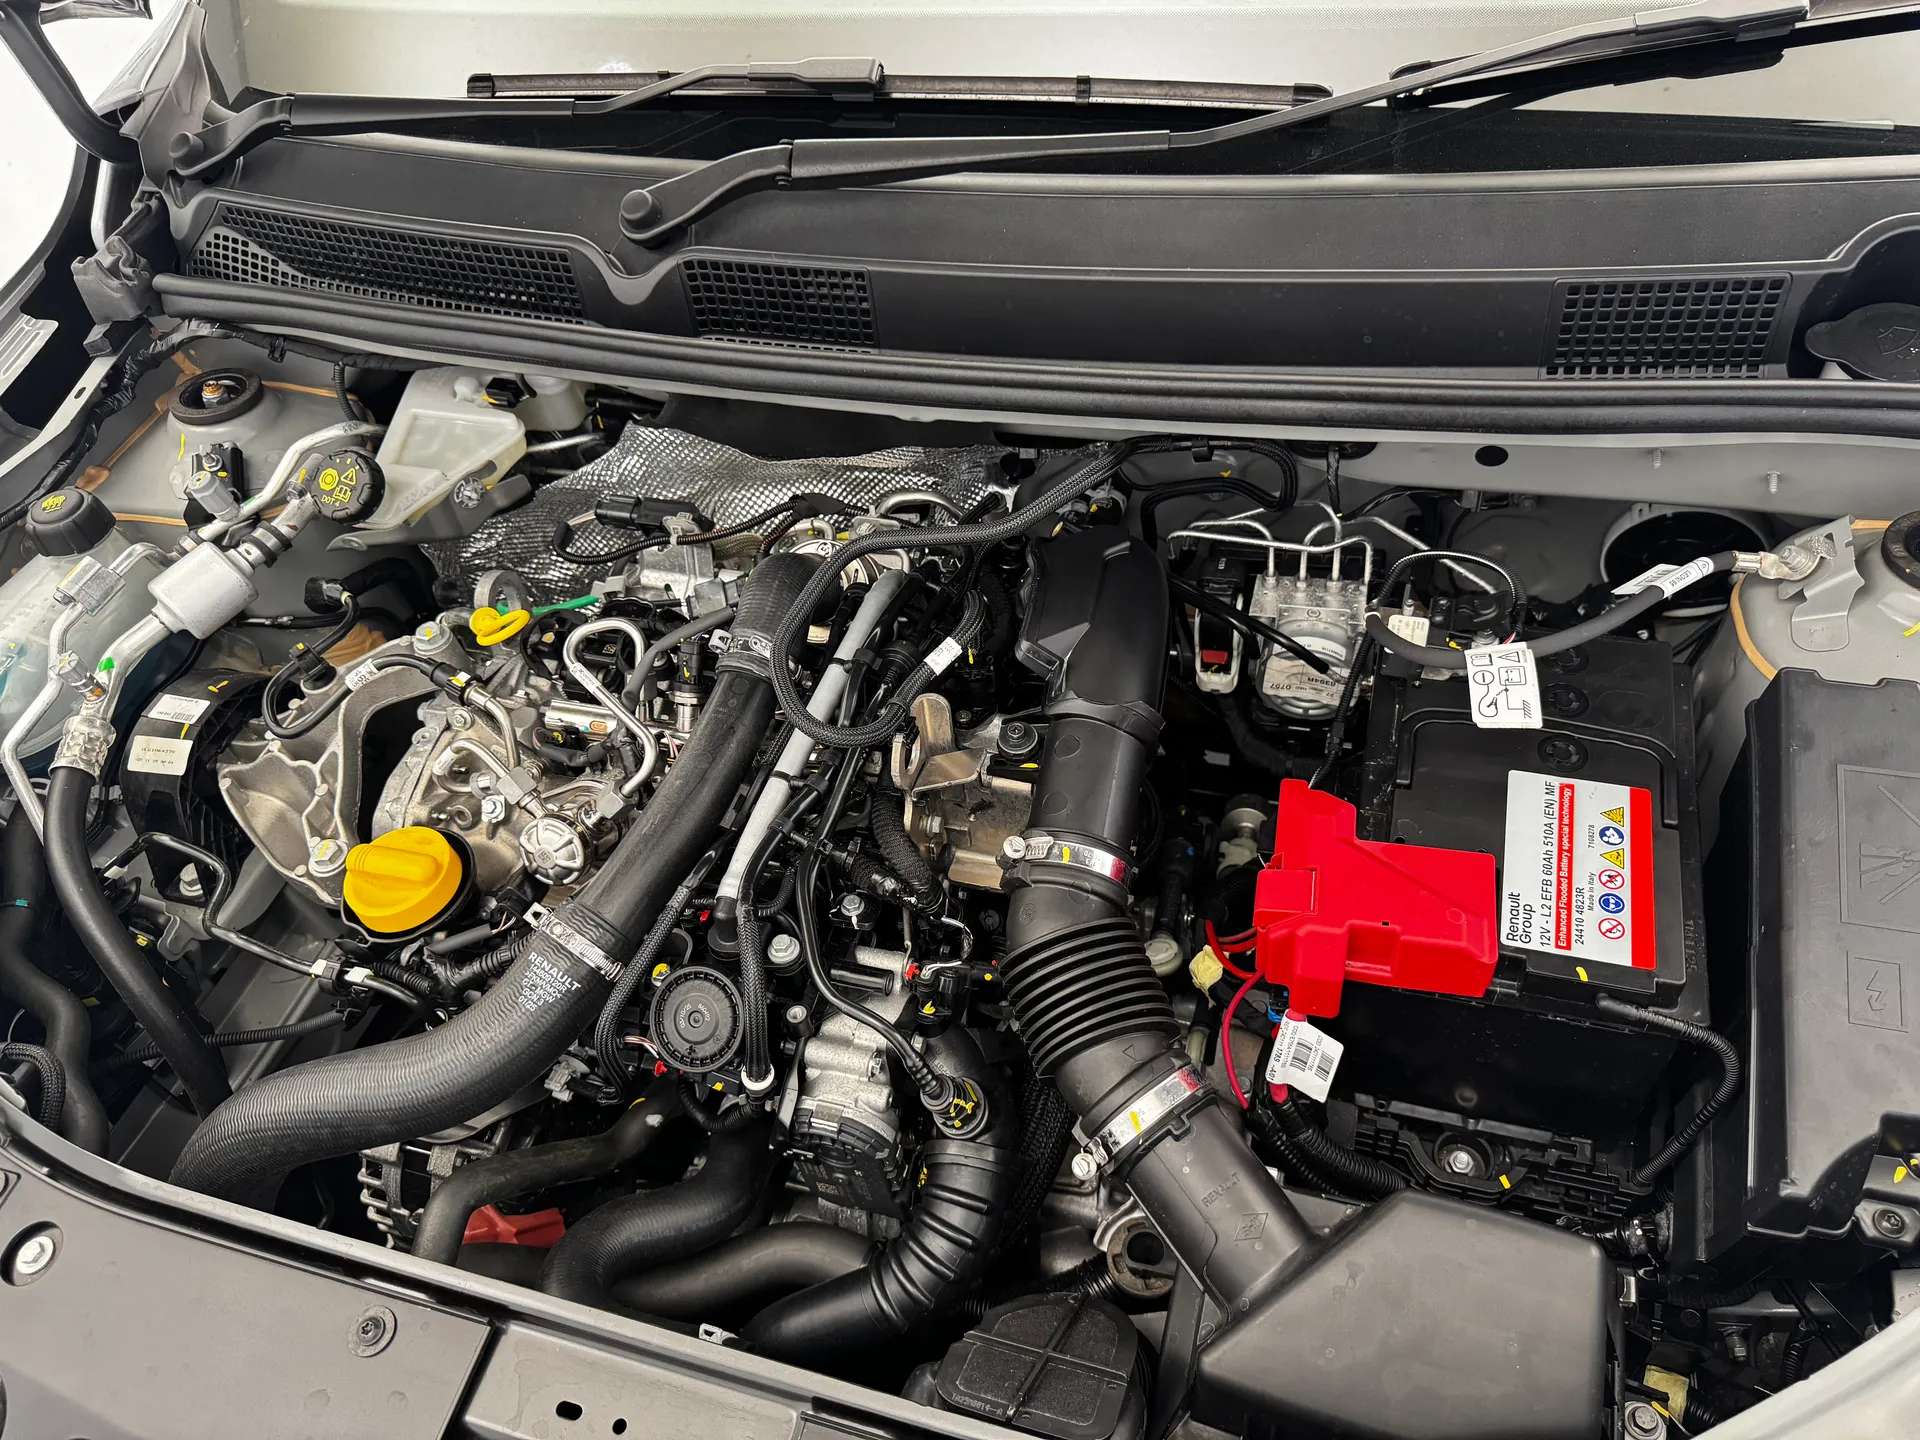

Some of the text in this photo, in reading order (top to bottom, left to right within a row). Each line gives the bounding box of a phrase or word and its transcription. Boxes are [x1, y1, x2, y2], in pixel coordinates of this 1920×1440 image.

[1545, 780, 1555, 795] MF
[1545, 796, 1556, 820] (EN)
[1544, 821, 1554, 847] 510A
[1542, 848, 1553, 875] 60Ah
[1558, 787, 1573, 946] Enhanced Flooded Battery special technology
[1542, 877, 1552, 902] EFB
[1588, 872, 1596, 883] Italy
[1506, 892, 1521, 942] Renault
[1519, 904, 1536, 944] Group
[1541, 905, 1551, 918] L2
[1575, 887, 1585, 945] 24410 4823R
[1540, 924, 1550, 947] 12V
[528, 952, 581, 990] RENAULT
